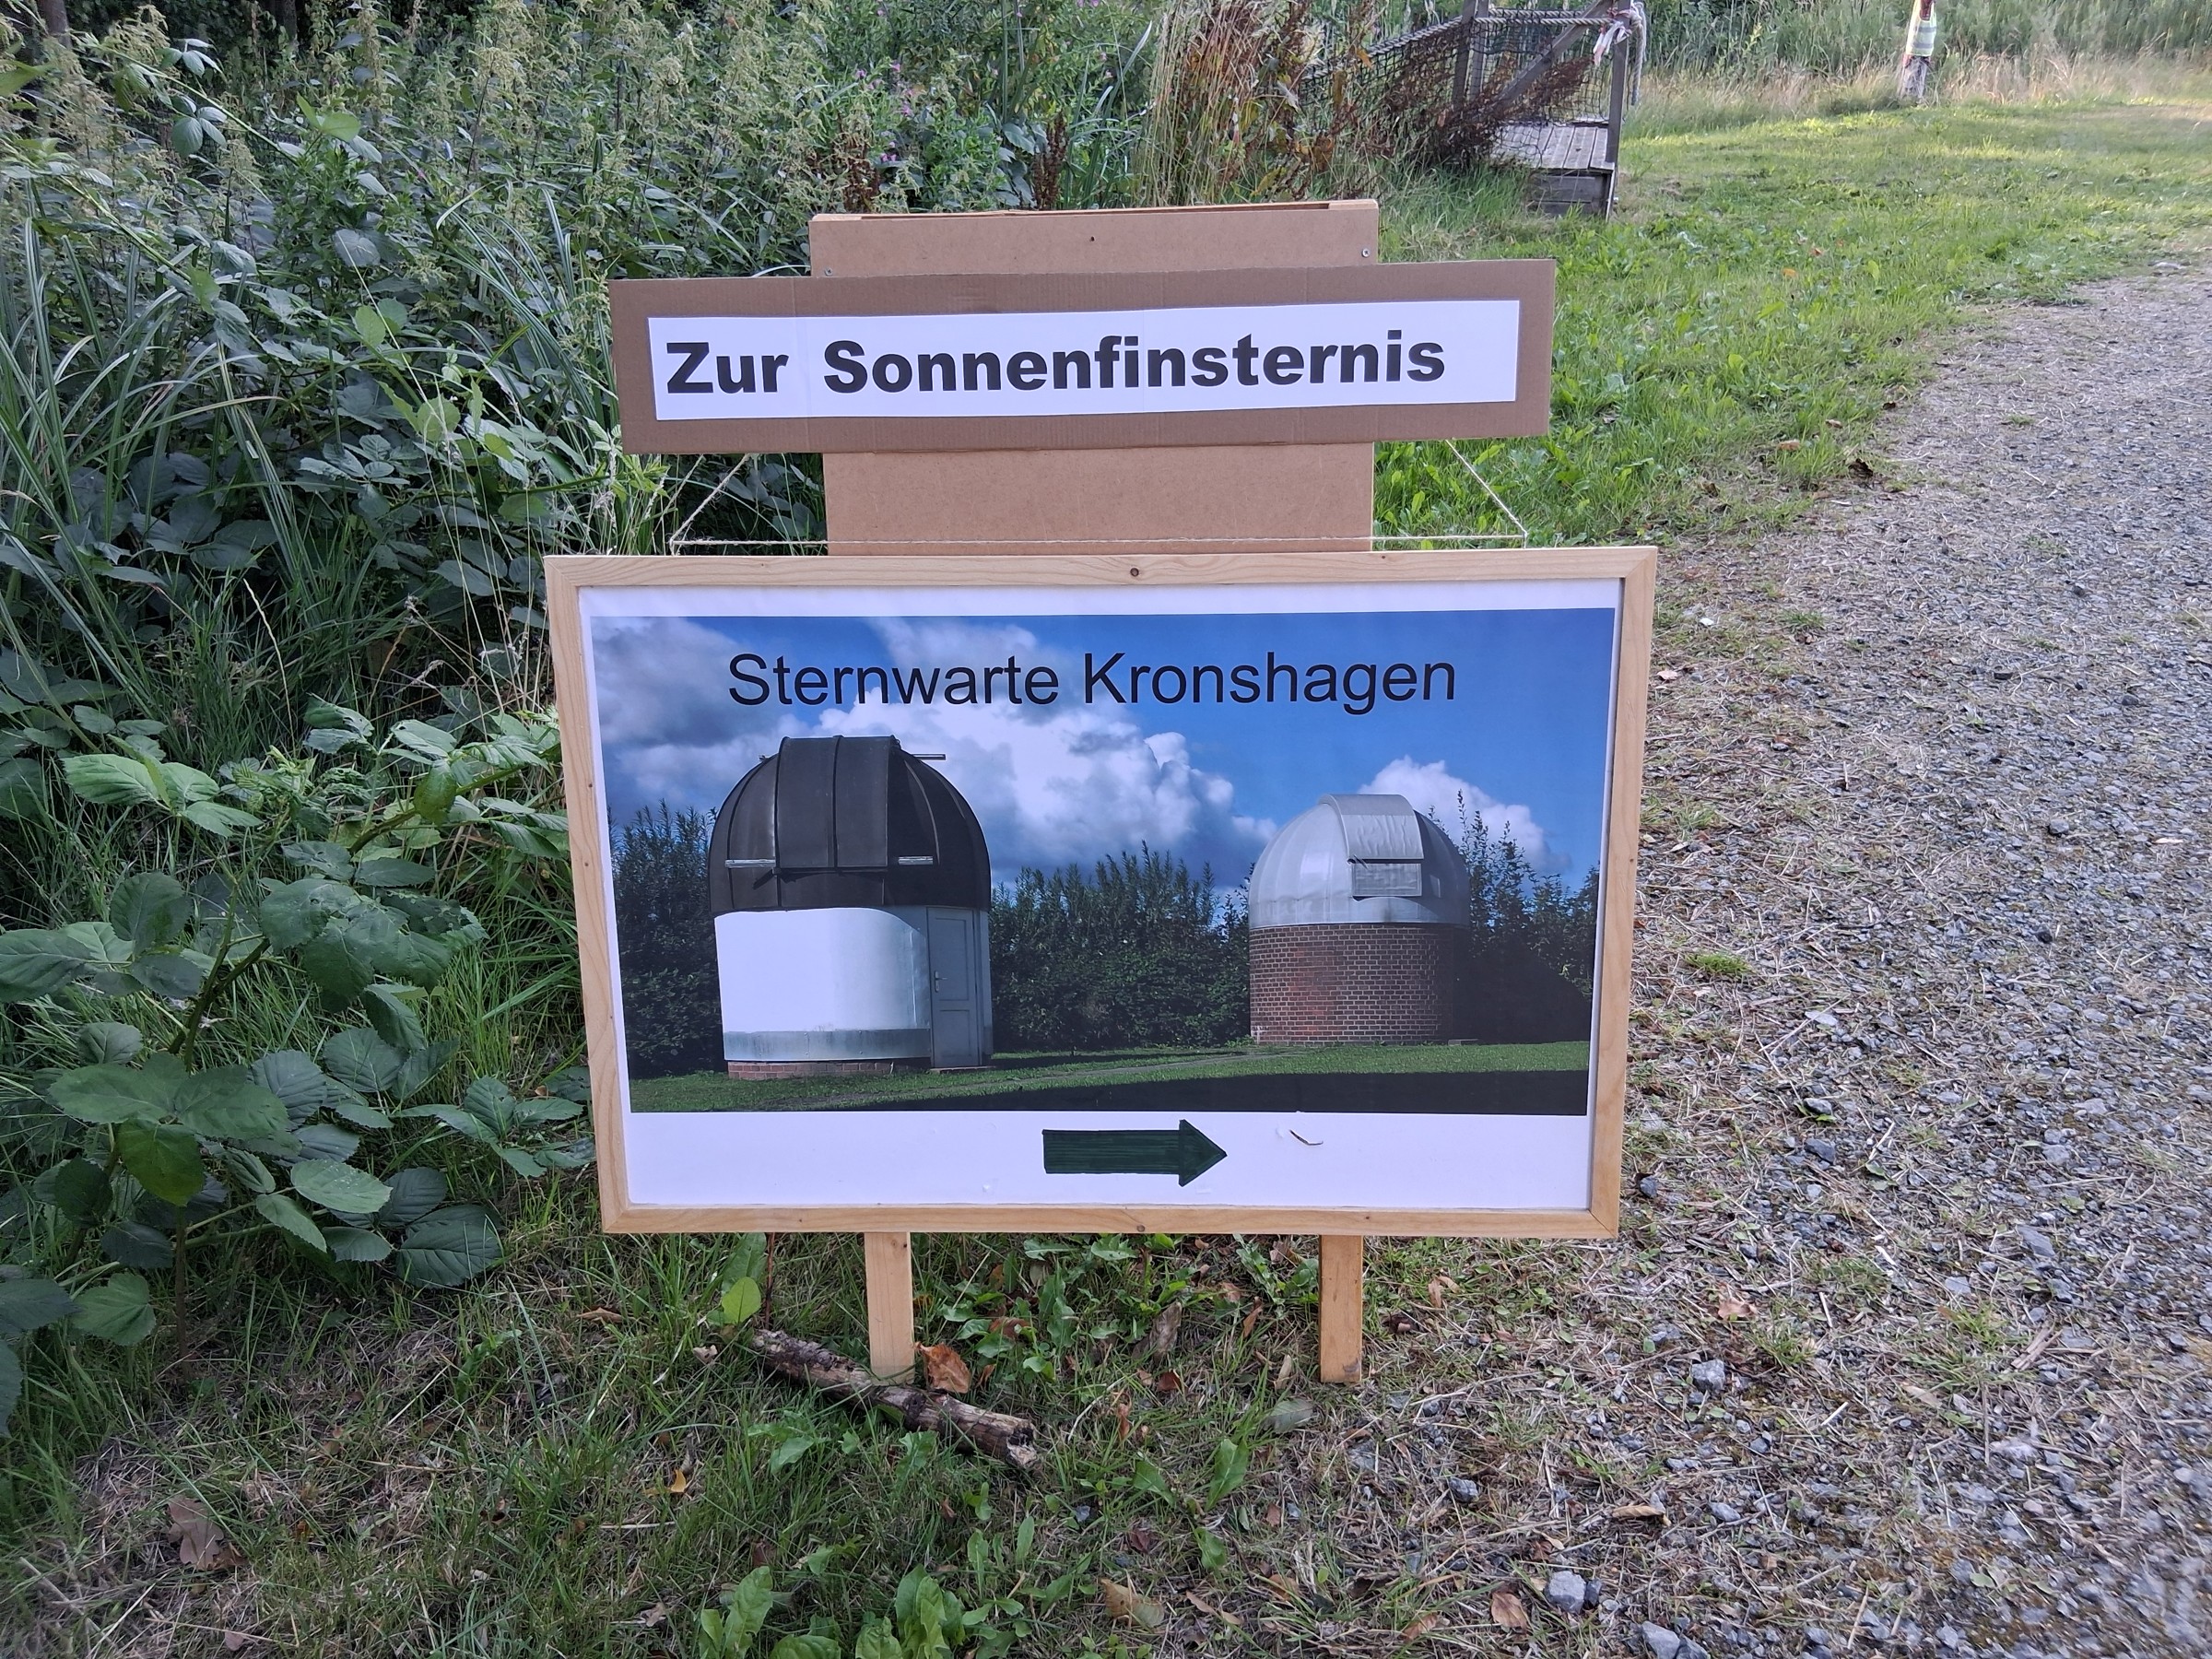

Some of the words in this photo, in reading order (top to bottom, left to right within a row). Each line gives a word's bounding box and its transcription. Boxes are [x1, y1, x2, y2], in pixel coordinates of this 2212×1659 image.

[666, 341, 790, 394] Zur
[823, 329, 1445, 394] Sonnenfinsternis
[729, 653, 1059, 706] Sternwarte
[1085, 652, 1456, 715] Kronshagen
